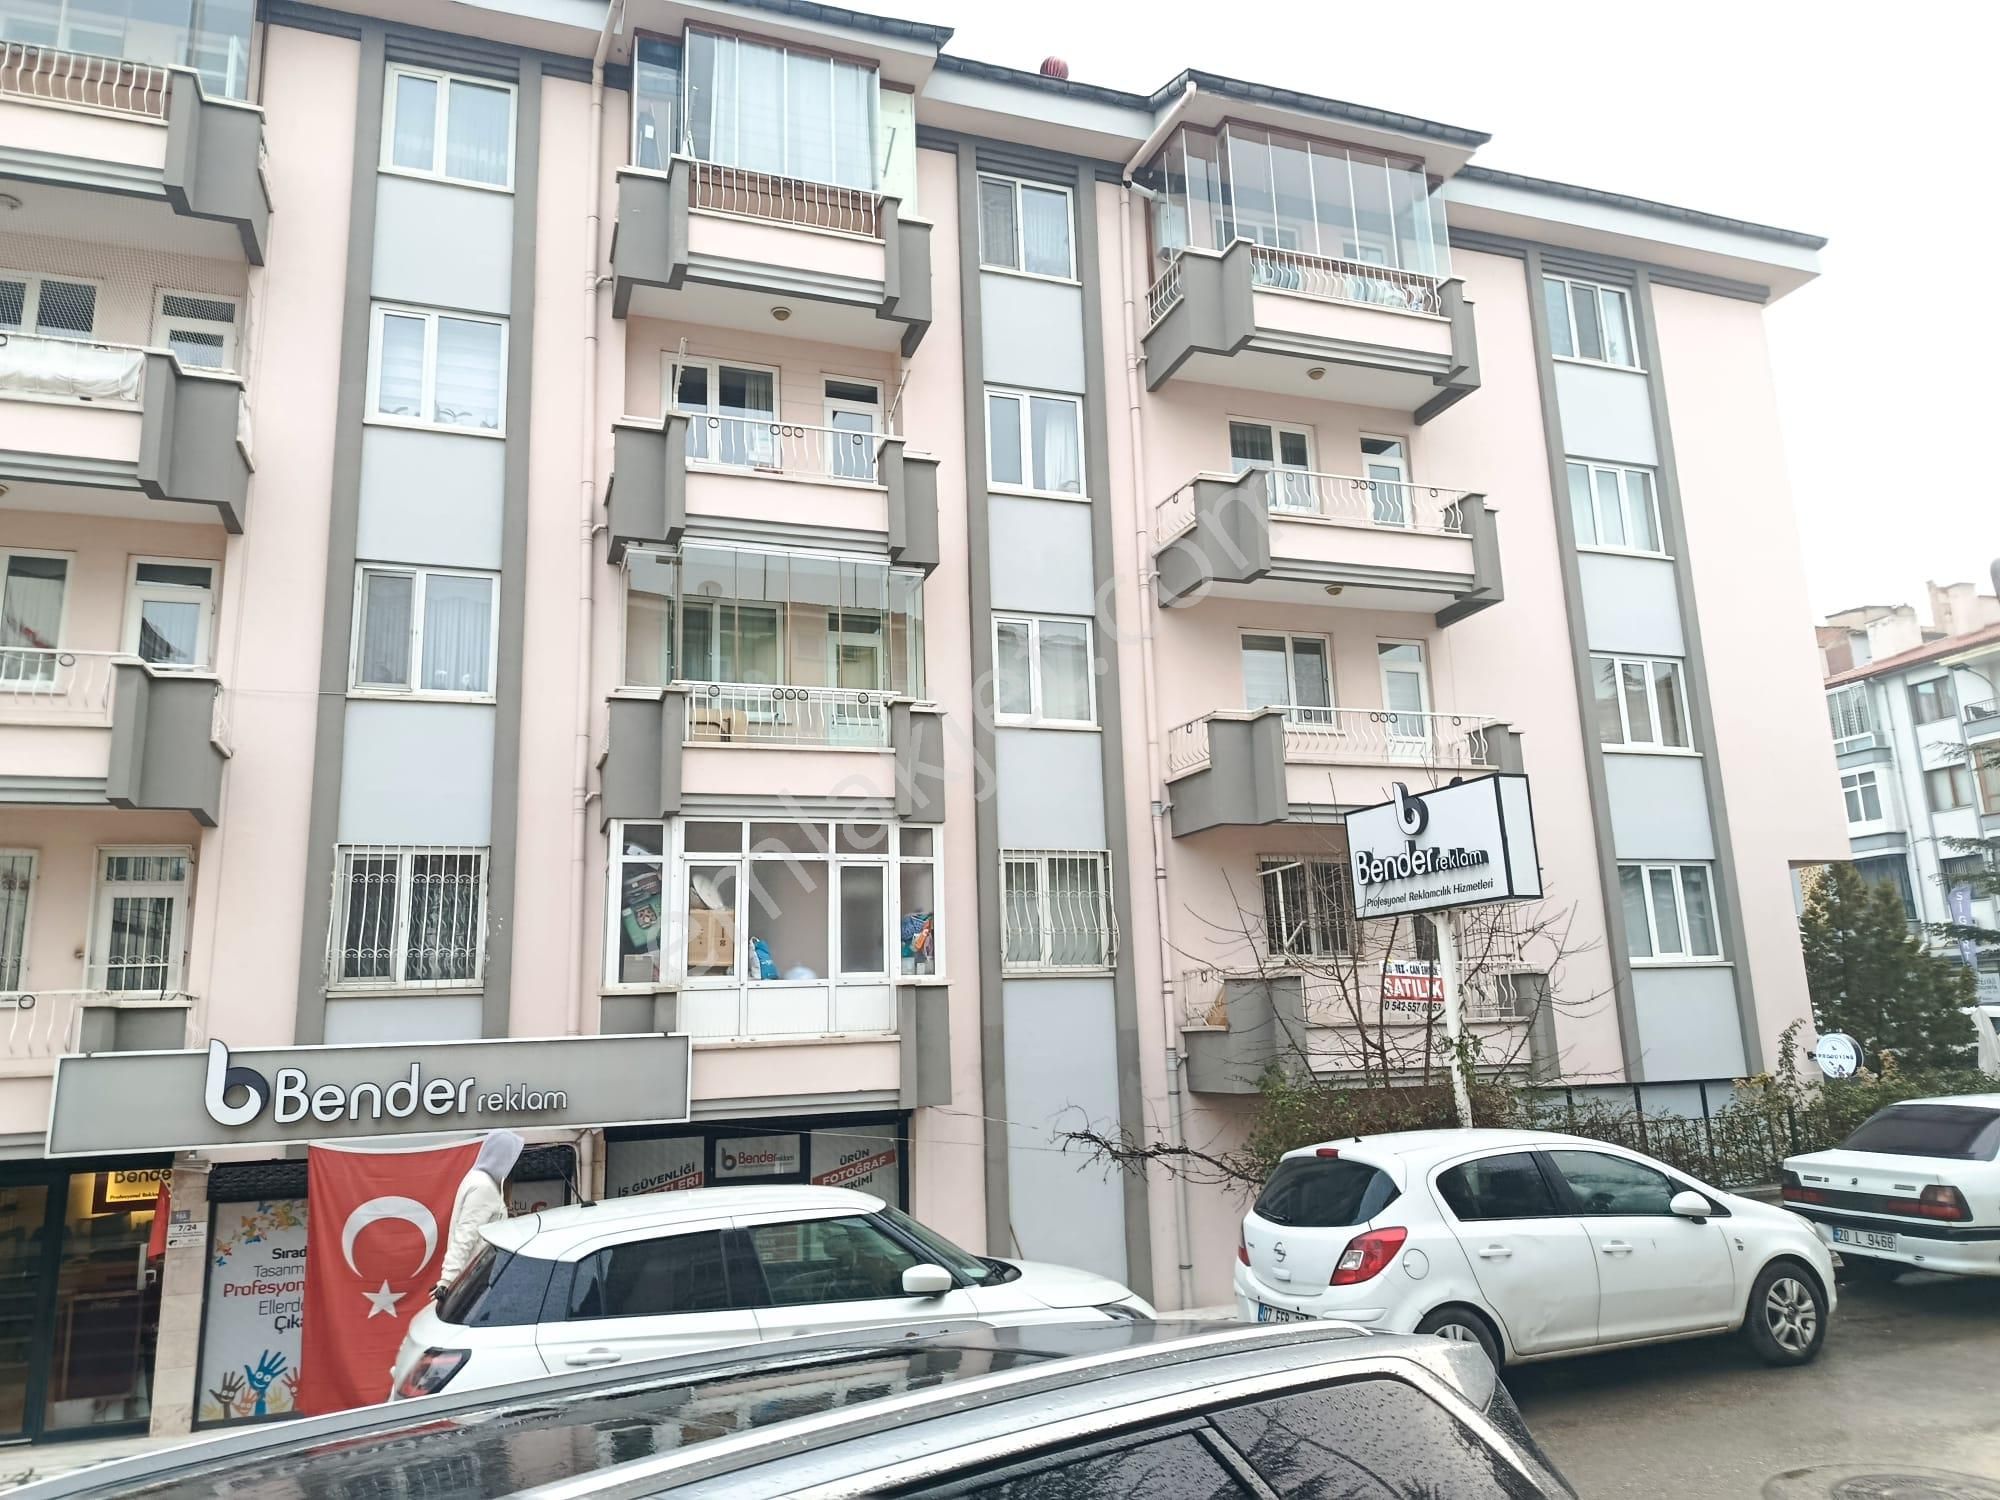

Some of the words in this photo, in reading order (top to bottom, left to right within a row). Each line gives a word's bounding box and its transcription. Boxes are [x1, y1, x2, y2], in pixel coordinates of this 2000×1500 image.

[1355, 840, 1437, 885] Bender
[1436, 847, 1485, 871] reklam
[1366, 893, 1406, 909] Profesyonel
[1453, 878, 1494, 895] Hizmetleri
[274, 1062, 475, 1124] Bender
[477, 1083, 568, 1113] reklam
[738, 1150, 776, 1165] Bender
[839, 1149, 870, 1166] ÜRÜN
[632, 1162, 696, 1192] GÜVENLİĞİ
[822, 1155, 888, 1187] FOTOĞRAF
[839, 1172, 873, 1190] EKİMİ
[178, 1223, 198, 1232] 7/24
[1839, 1229, 1850, 1242] 20
[1855, 1231, 1862, 1244] L
[258, 1296, 304, 1316] Ellerd
